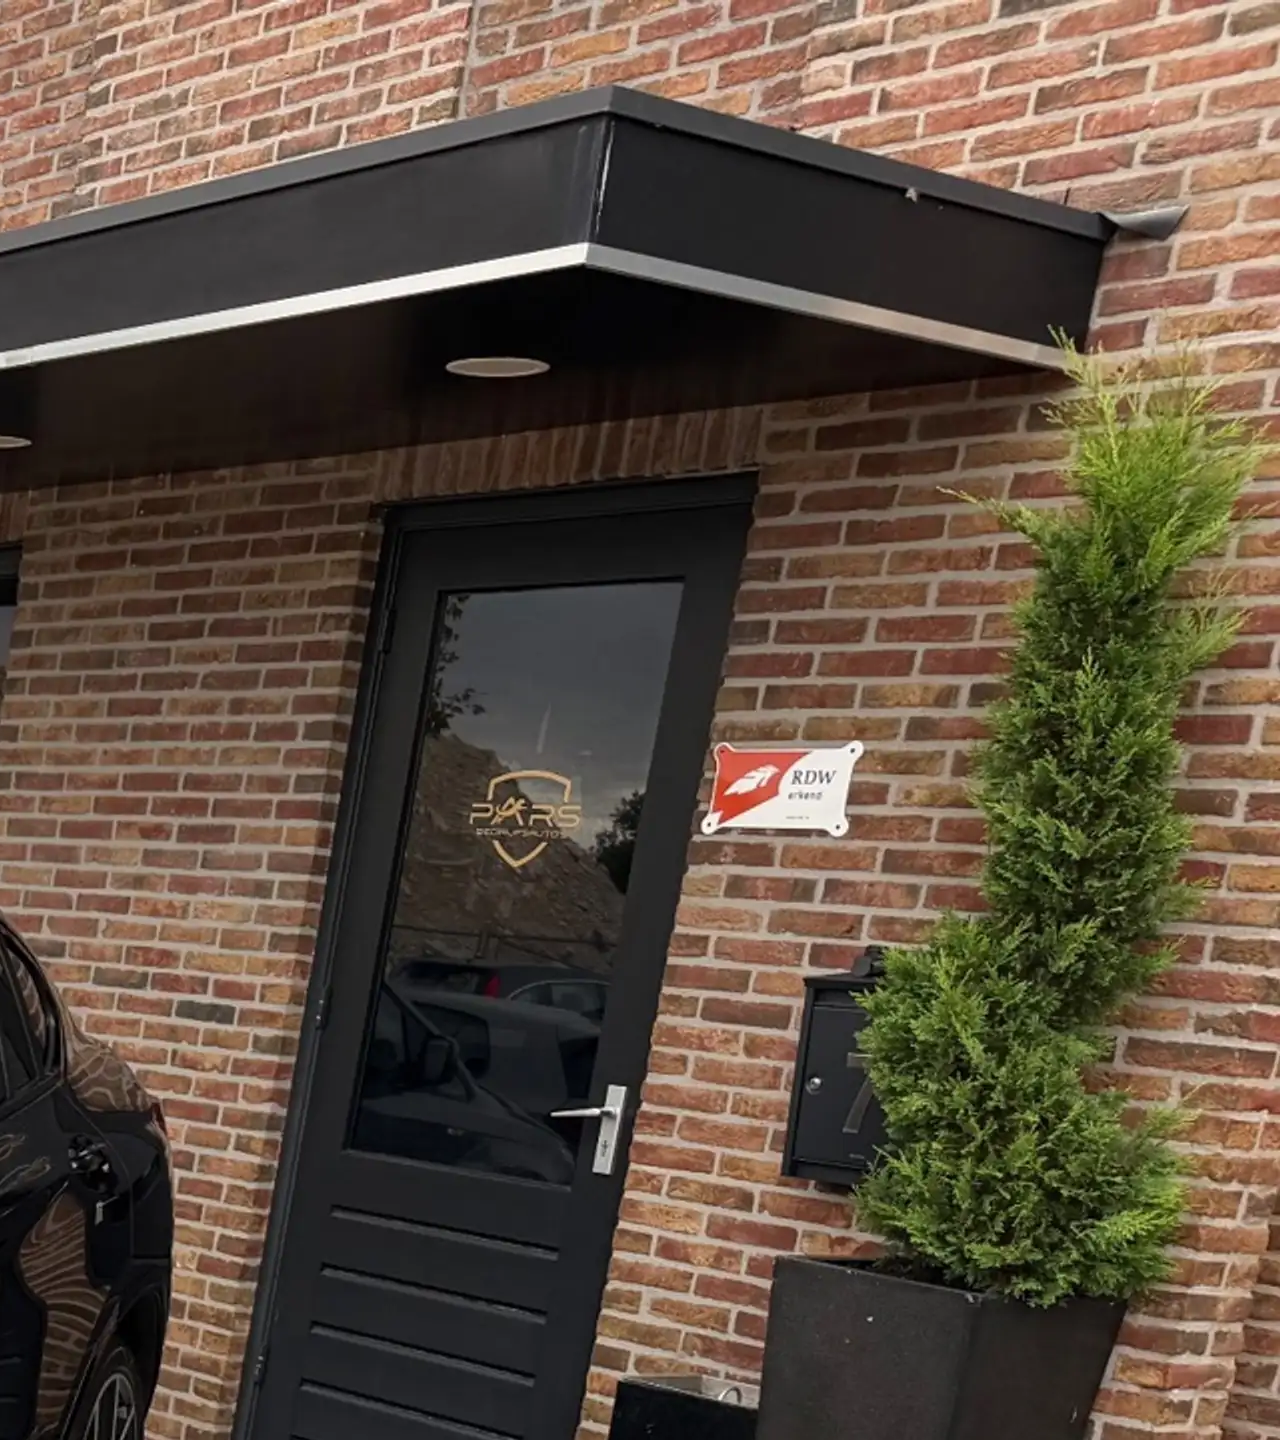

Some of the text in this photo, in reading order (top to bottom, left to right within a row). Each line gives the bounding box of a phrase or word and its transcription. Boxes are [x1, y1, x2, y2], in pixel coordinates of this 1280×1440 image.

[791, 769, 837, 786] RDW
[787, 791, 823, 801] erkend
[469, 797, 582, 827] PARS
